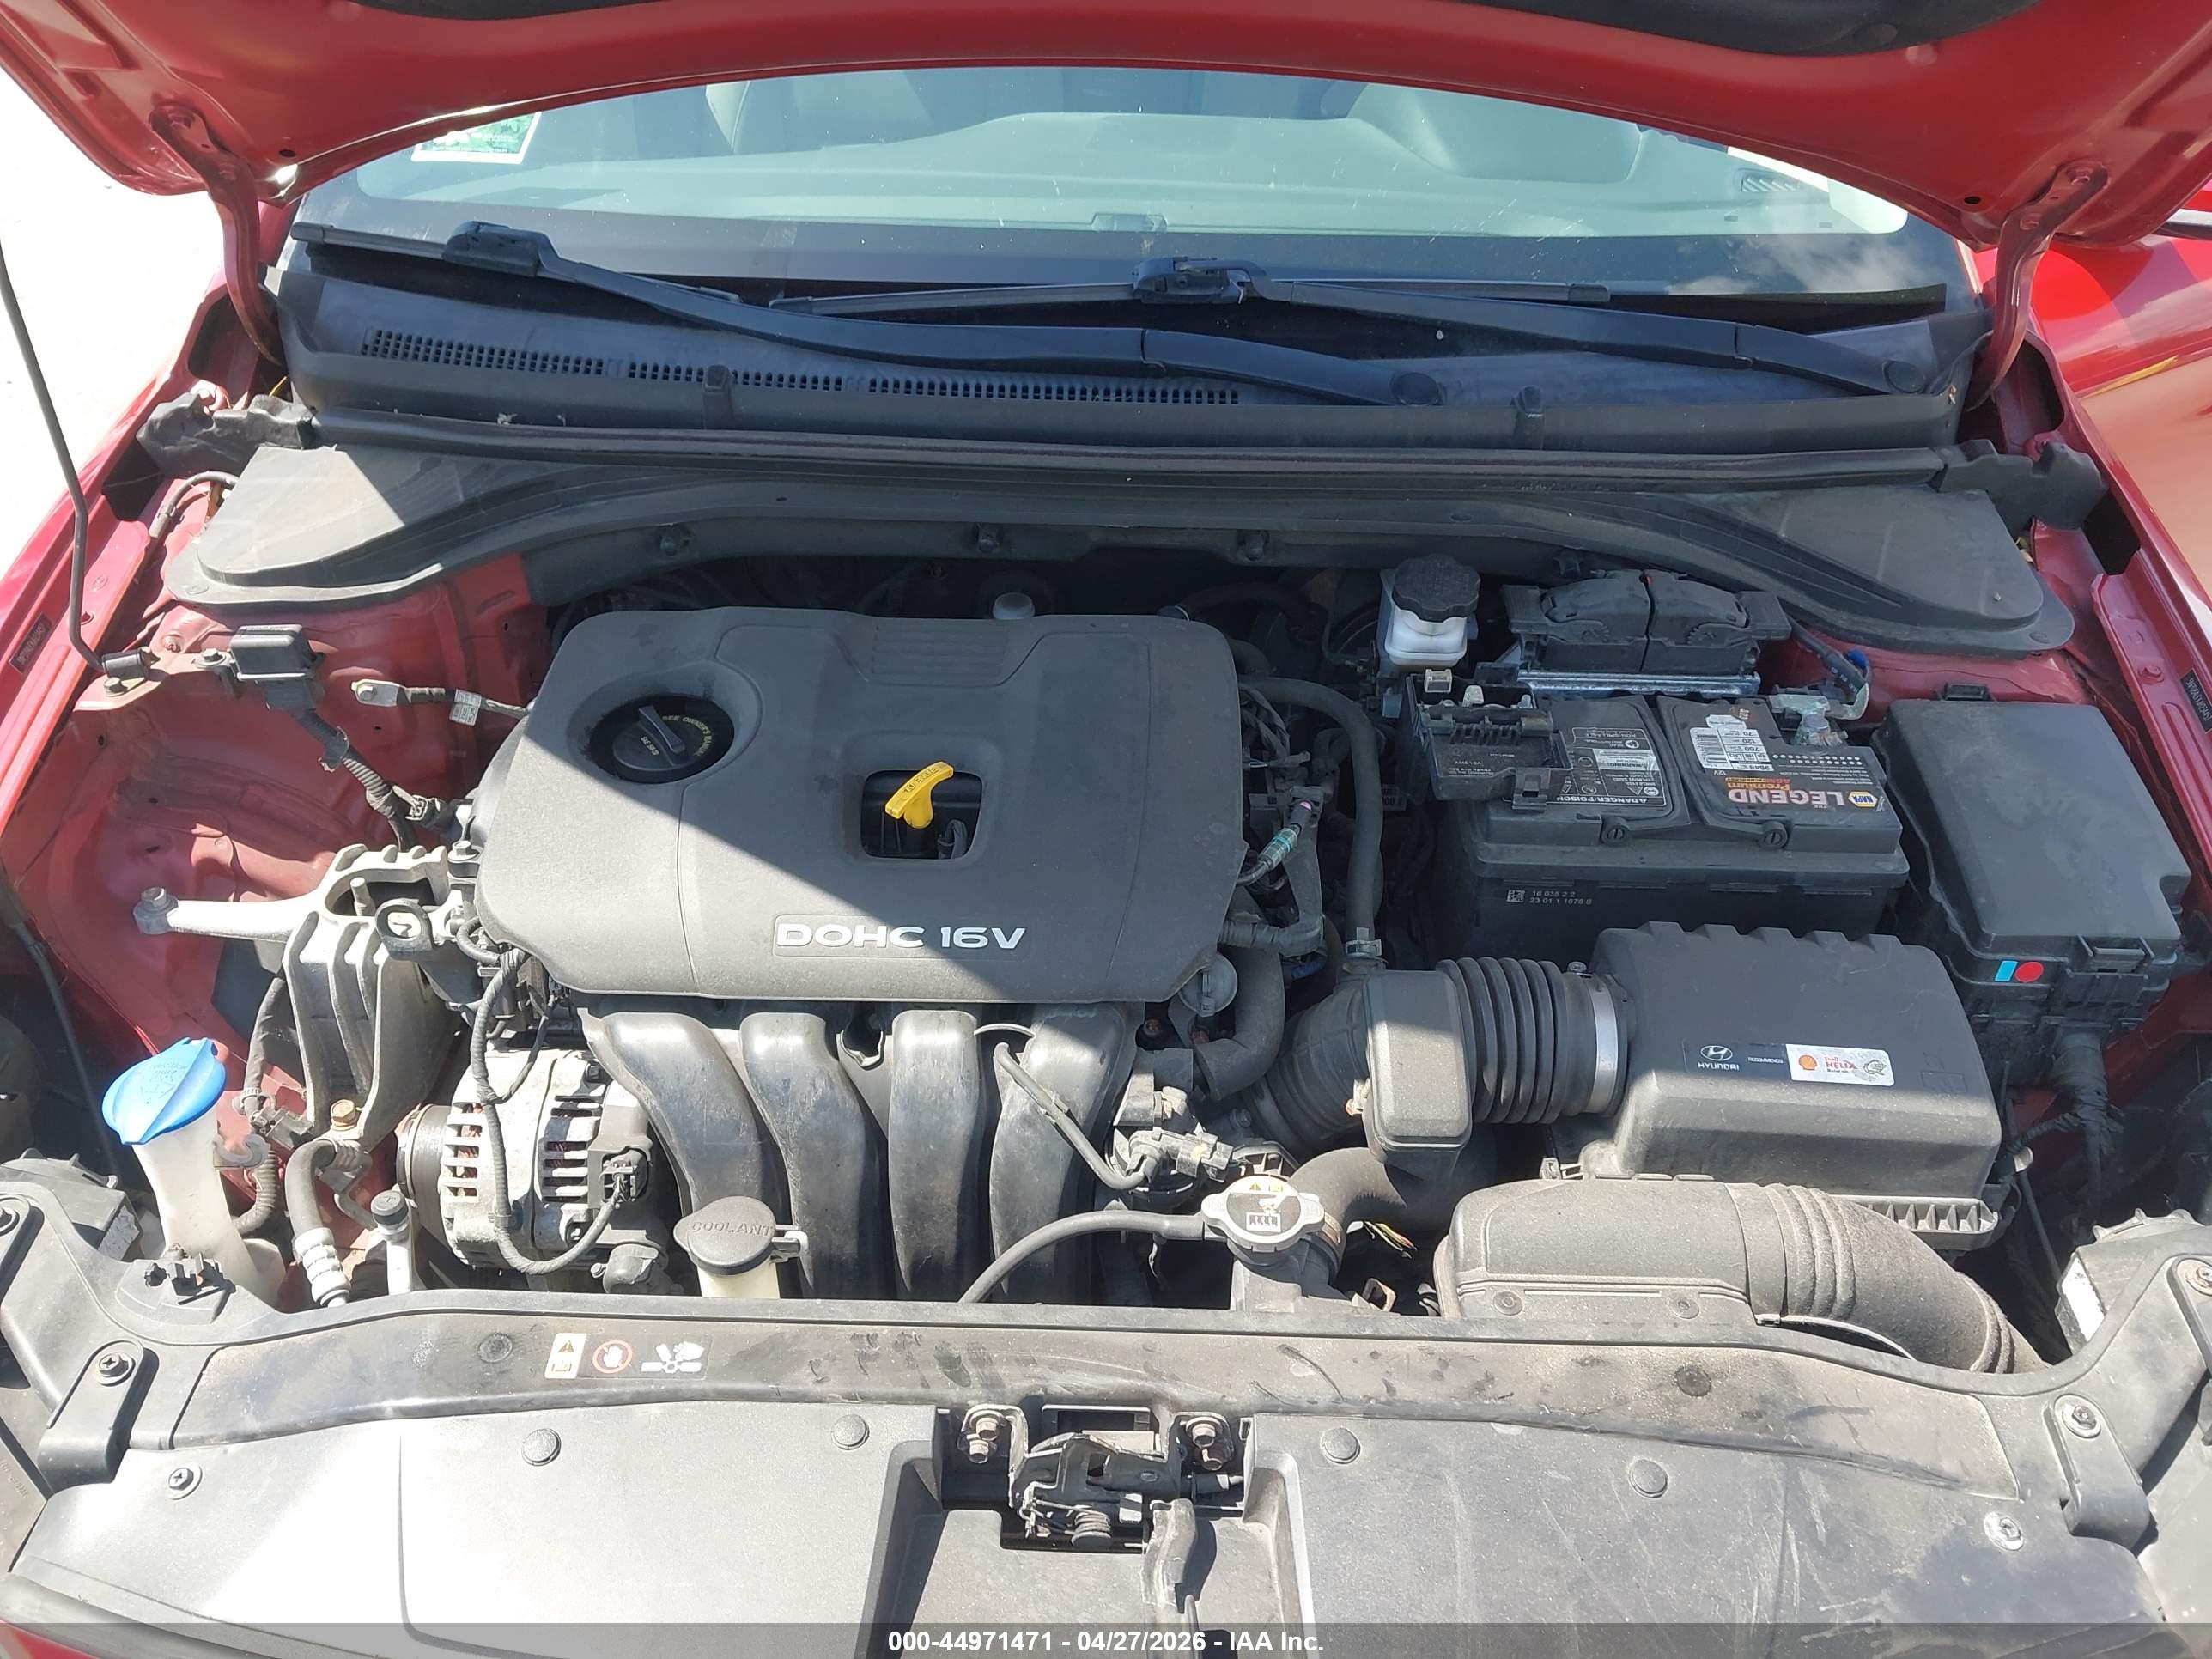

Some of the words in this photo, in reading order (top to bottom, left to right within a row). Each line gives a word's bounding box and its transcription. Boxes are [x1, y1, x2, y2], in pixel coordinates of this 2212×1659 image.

[1728, 782, 1790, 791] Premium
[1728, 788, 1846, 805] LEGEND
[775, 923, 926, 948] DOHC
[940, 927, 1026, 949] 16V
[1698, 1062, 1740, 1071] HYUNDAI
[1826, 1060, 1858, 1070] HELIX
[691, 1221, 773, 1237] COOLANT
